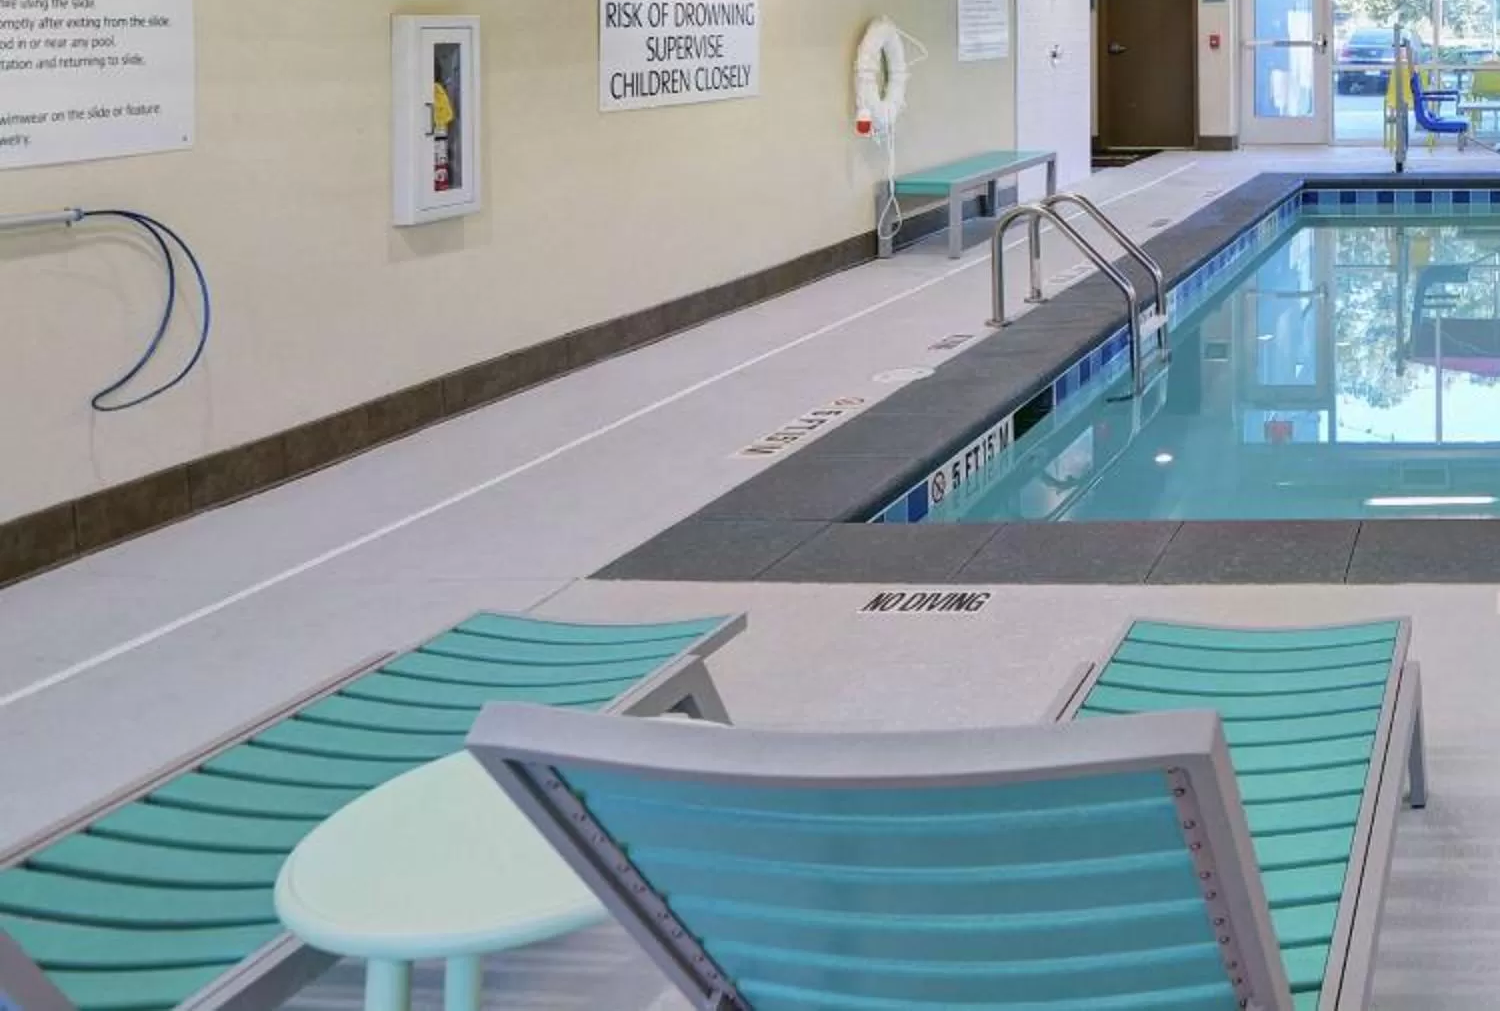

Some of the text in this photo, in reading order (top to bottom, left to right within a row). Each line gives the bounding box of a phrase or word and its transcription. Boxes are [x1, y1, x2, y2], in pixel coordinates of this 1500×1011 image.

[38, 16, 63, 29] after
[605, 2, 755, 28] RISK OF DROWNING
[645, 34, 724, 62] SUPERVISE
[609, 64, 751, 100] CHILDREN CLOSELY
[51, 112, 65, 122] on
[952, 461, 960, 489] 5
[998, 421, 1009, 452] M
[860, 592, 991, 612] NO DIVING
